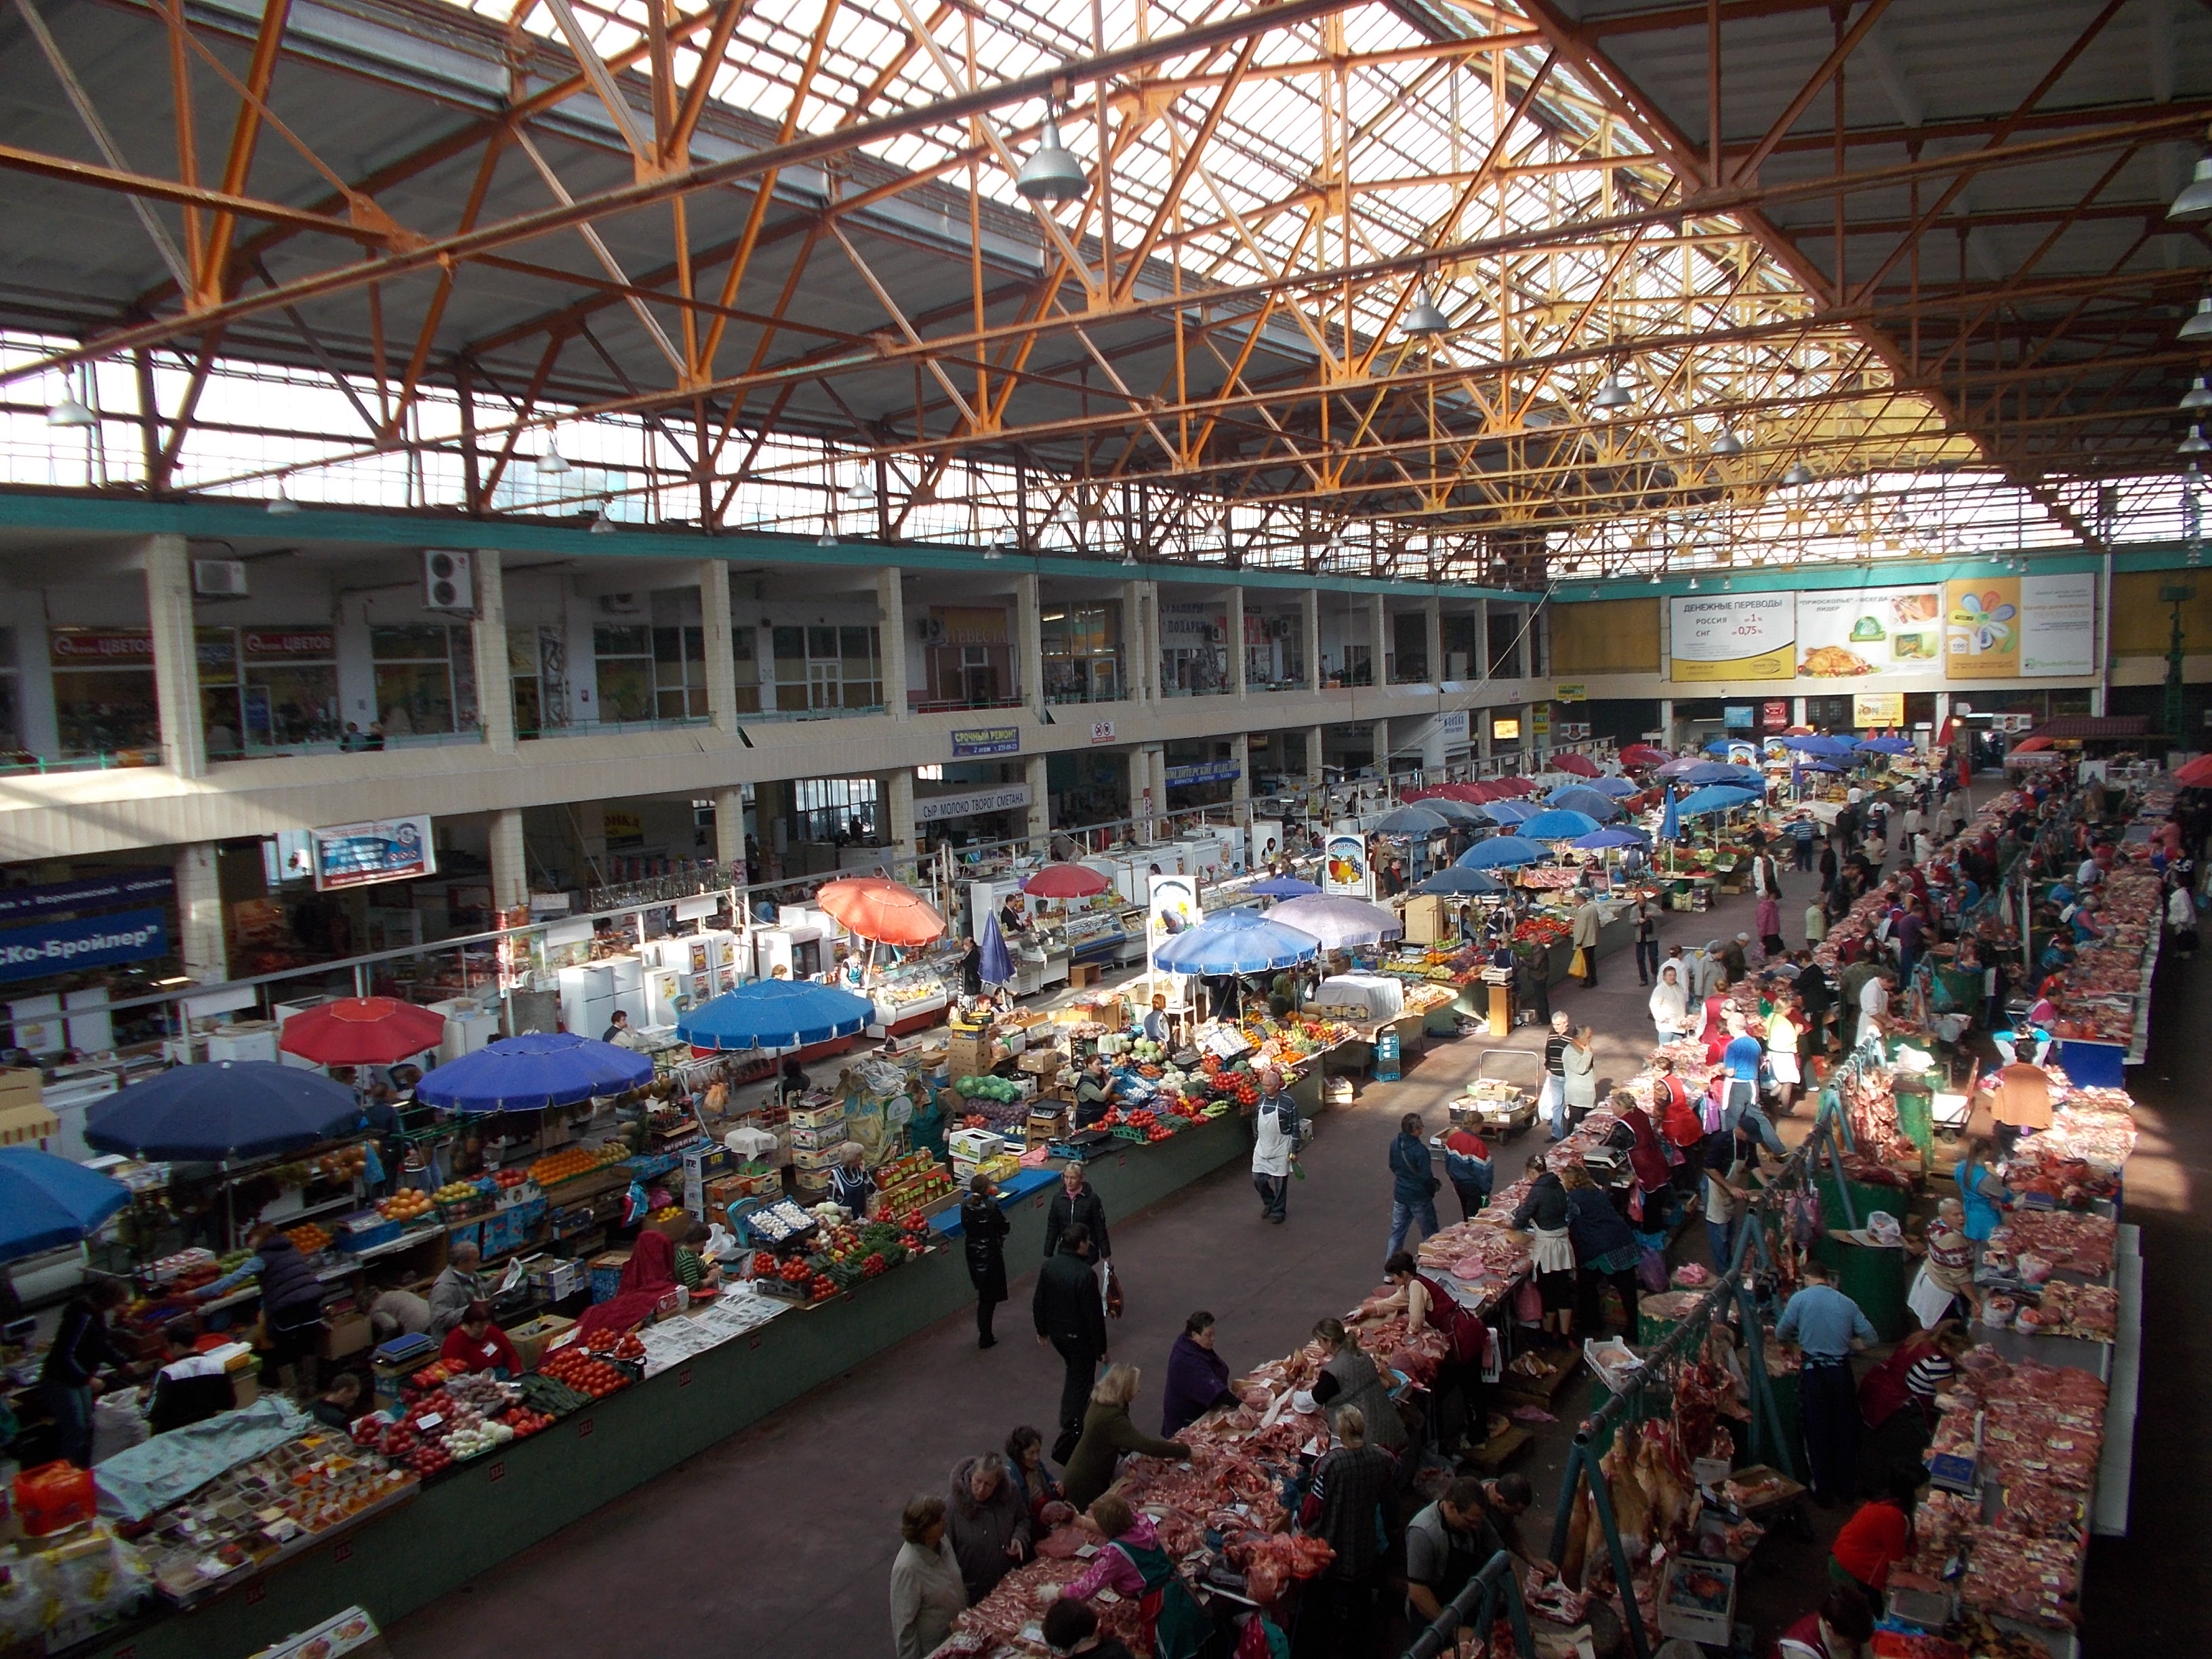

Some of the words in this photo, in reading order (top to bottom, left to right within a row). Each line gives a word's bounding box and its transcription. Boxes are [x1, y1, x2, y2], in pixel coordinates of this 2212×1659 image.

[1160, 603, 1204, 613] СУВЕНИРЫ
[1683, 602, 1732, 613] ДЕНЕЖНЫЕ
[1735, 600, 1782, 609] ПЕРЕВОДЫ
[946, 627, 1007, 643] НЕВЕСТА
[283, 636, 331, 651] ЦВЕТОВ
[955, 731, 989, 742] СРОЧНЫЙ
[990, 730, 1017, 739] РЕМОНТ
[924, 806, 937, 818] СЫР
[941, 801, 968, 815] МОЛОКО
[972, 797, 994, 811] ТВОРОГ
[997, 792, 1024, 807] СМЕТАНА
